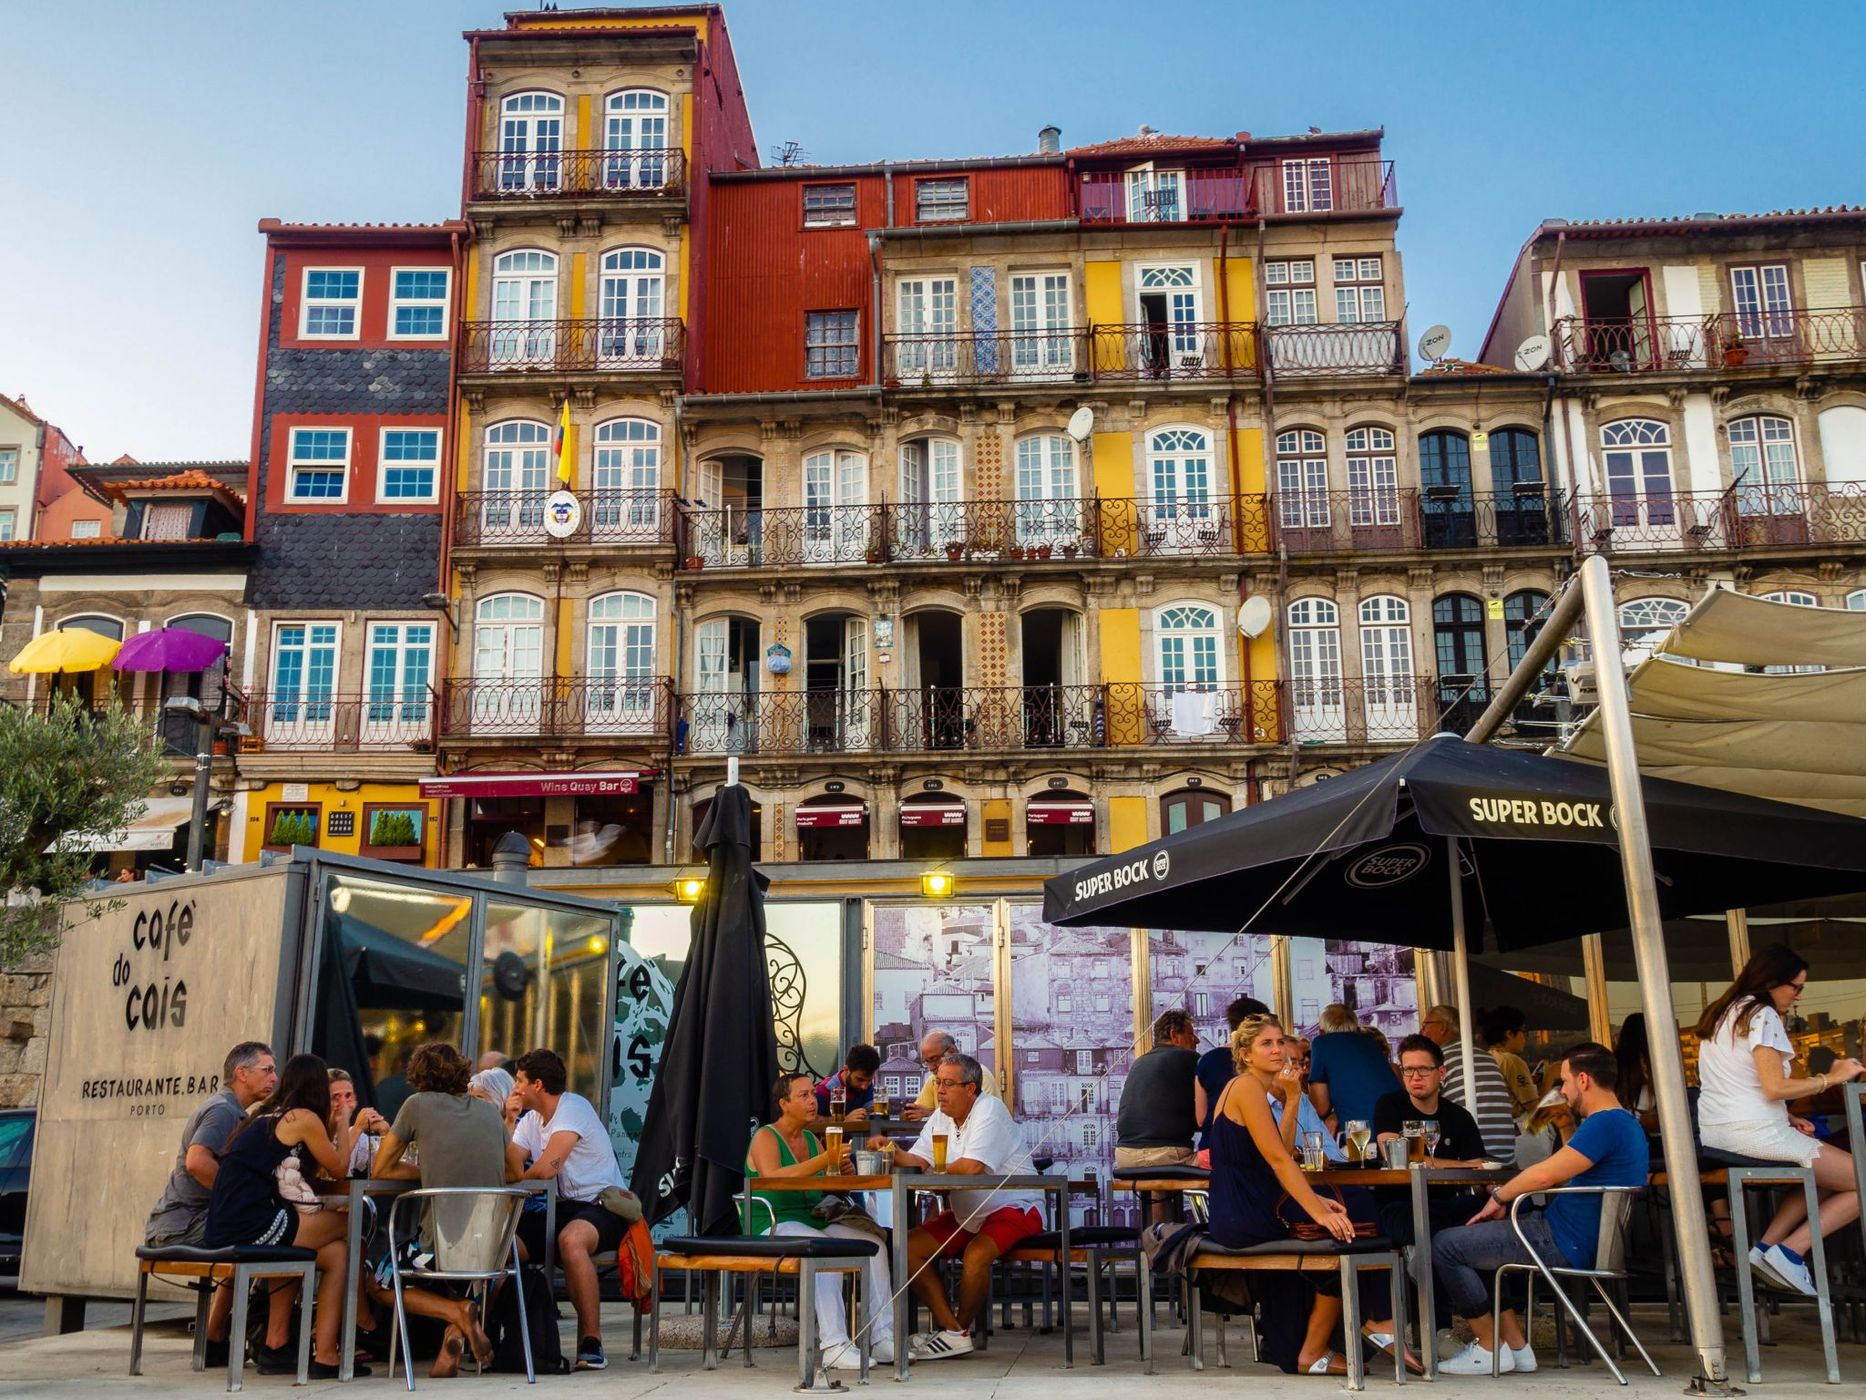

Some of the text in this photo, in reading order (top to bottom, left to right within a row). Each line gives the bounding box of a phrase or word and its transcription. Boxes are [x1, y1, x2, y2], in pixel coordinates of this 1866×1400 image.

[1426, 334, 1444, 346] ZON
[1524, 344, 1543, 355] ZON
[541, 780, 619, 793] Wine Quay Bar
[1469, 797, 1604, 828] SUPER BOCK
[1367, 856, 1417, 868] SUPER
[1360, 865, 1406, 876] BOCK
[1074, 858, 1150, 902] SUPER BOCK
[113, 952, 131, 987] do
[125, 976, 188, 1032] cais
[130, 1103, 166, 1117] PORTO
